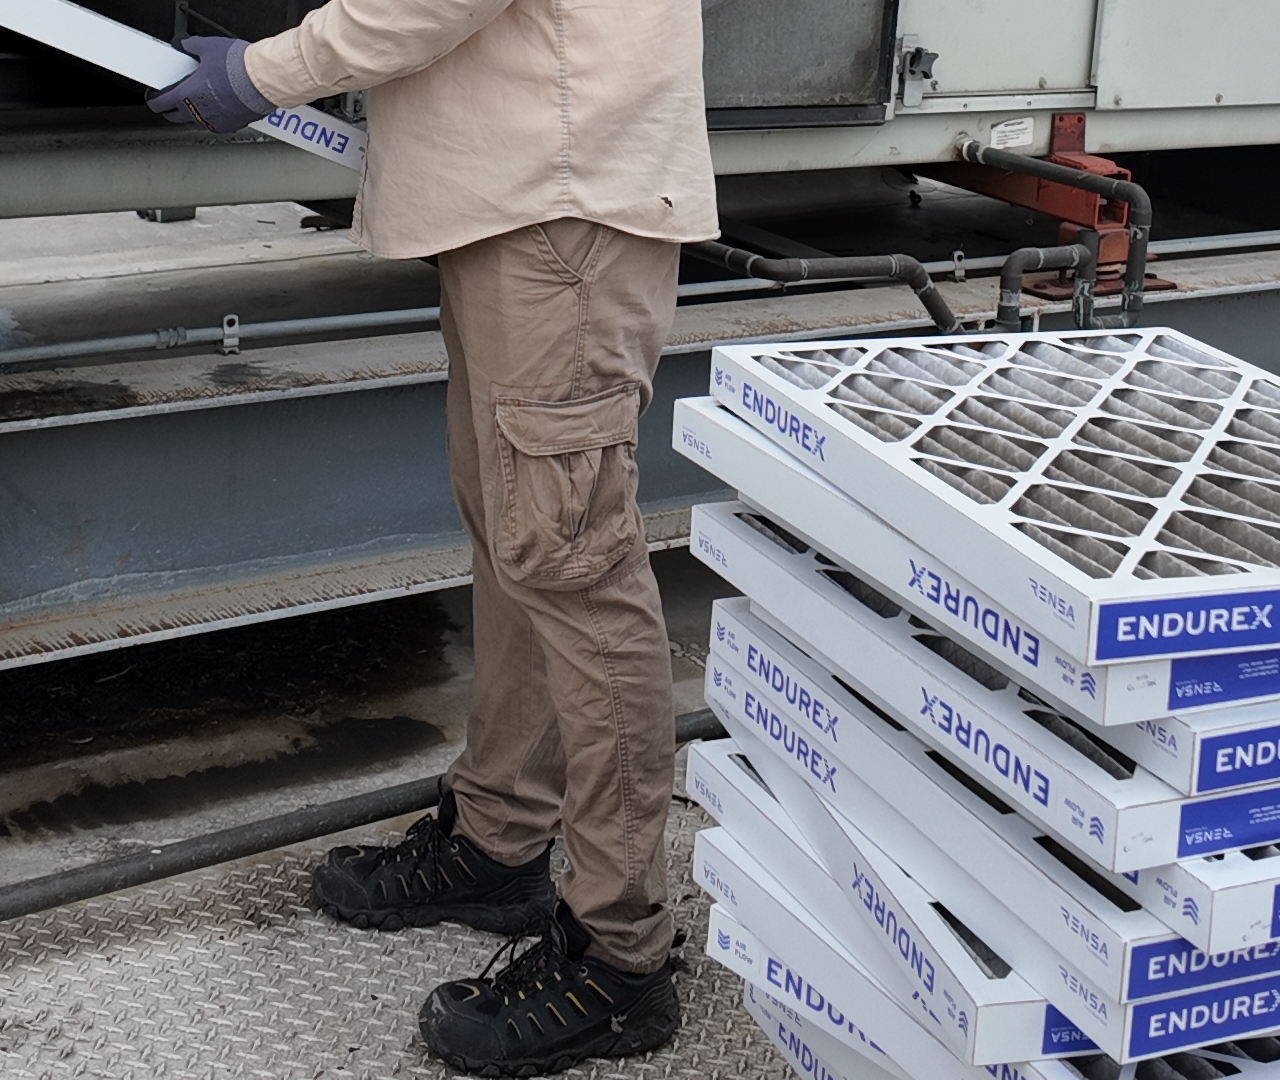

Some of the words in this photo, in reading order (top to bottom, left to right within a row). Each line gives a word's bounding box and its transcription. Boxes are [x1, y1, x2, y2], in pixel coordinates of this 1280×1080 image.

[267, 110, 349, 154] ENDUR
[682, 430, 712, 460] RENSA
[742, 382, 826, 462] ENDUREX
[698, 535, 728, 568] RENSA
[908, 558, 1040, 668] ENDUREX
[1028, 577, 1076, 623] RENSA
[1116, 604, 1273, 642] ENDUREX
[747, 643, 839, 743] ENDUREX
[1175, 681, 1223, 699] RENSA
[744, 690, 837, 793] ENDUREX
[920, 685, 1050, 808] ENDUREX
[1135, 721, 1178, 752] ENSA
[1185, 827, 1234, 846] RENSA
[703, 864, 738, 907] RENSA
[851, 861, 935, 994] ENDUREX
[1059, 905, 1109, 960] RENSA
[1058, 964, 1108, 1020] RENSA
